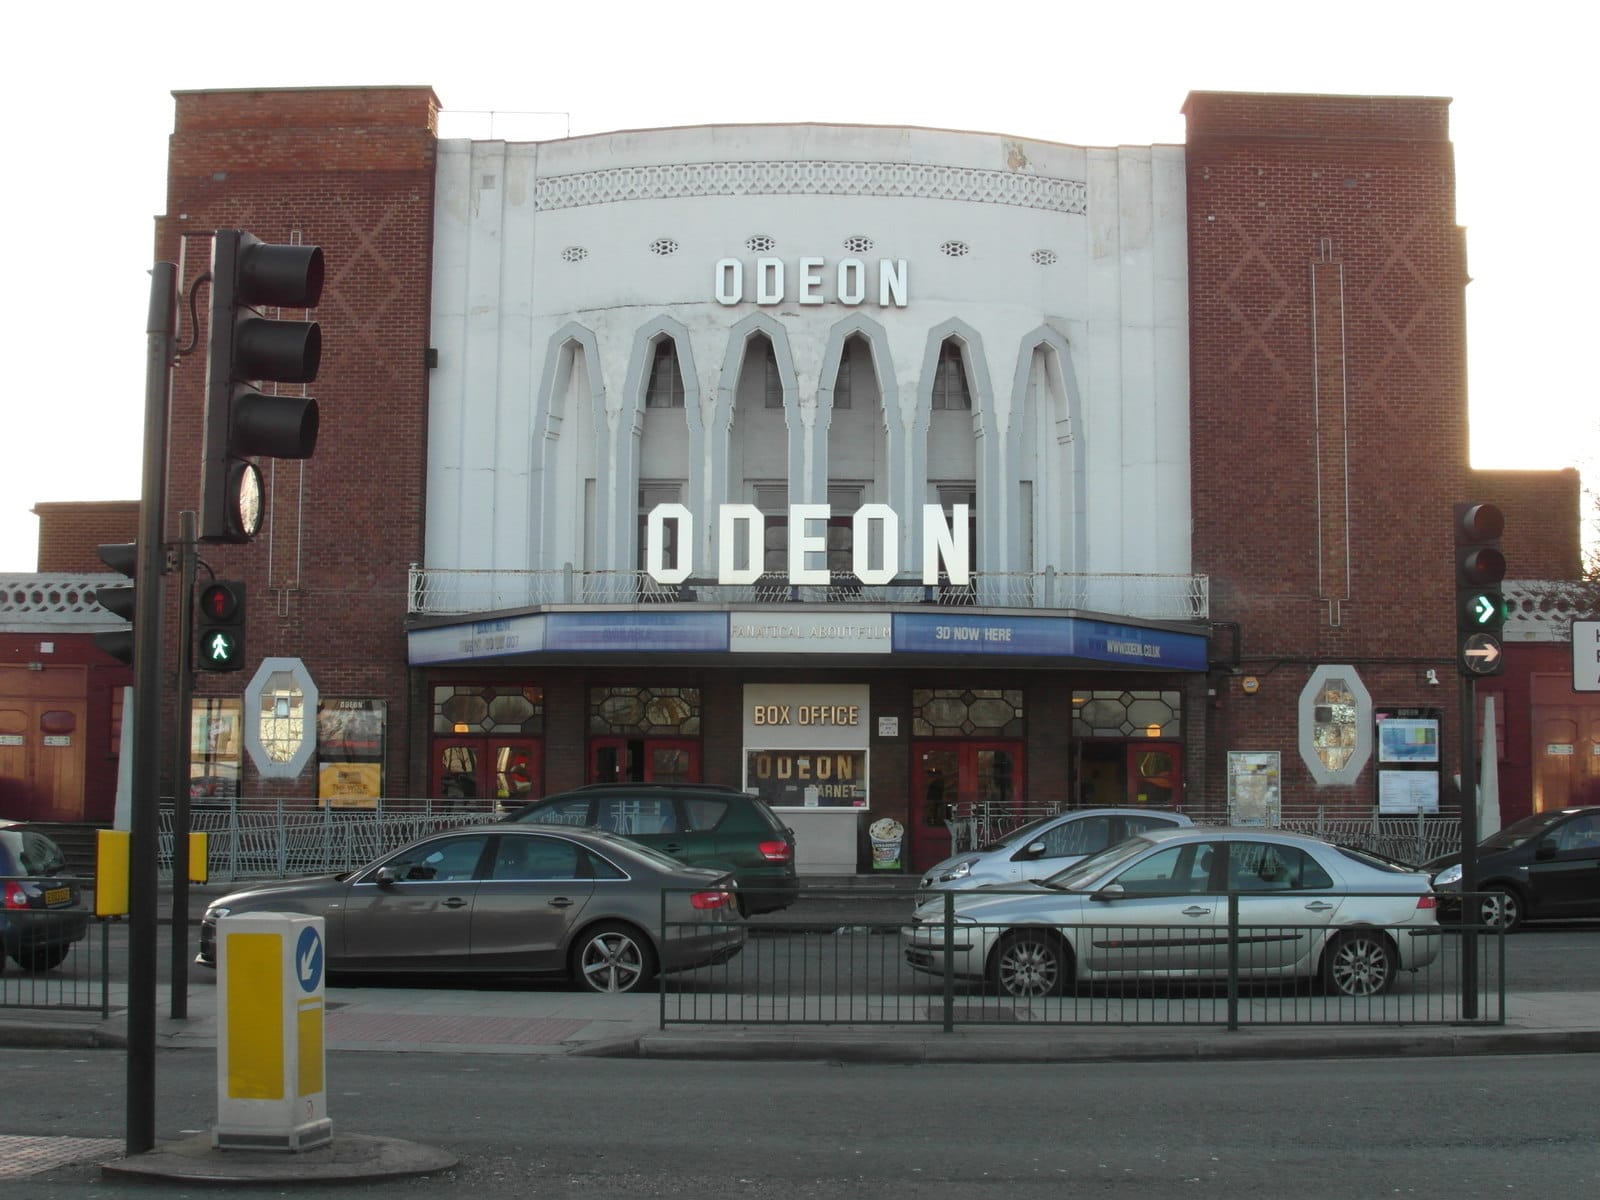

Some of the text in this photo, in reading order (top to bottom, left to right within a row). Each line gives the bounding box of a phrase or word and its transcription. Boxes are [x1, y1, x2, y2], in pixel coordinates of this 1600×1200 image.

[715, 256, 909, 307] ODEON
[647, 502, 970, 586] ODEON
[731, 624, 892, 640] FANATICAL ABOUT FILM
[935, 626, 1012, 642] 3D NOW HERE
[754, 705, 858, 725] BOX OFFICE
